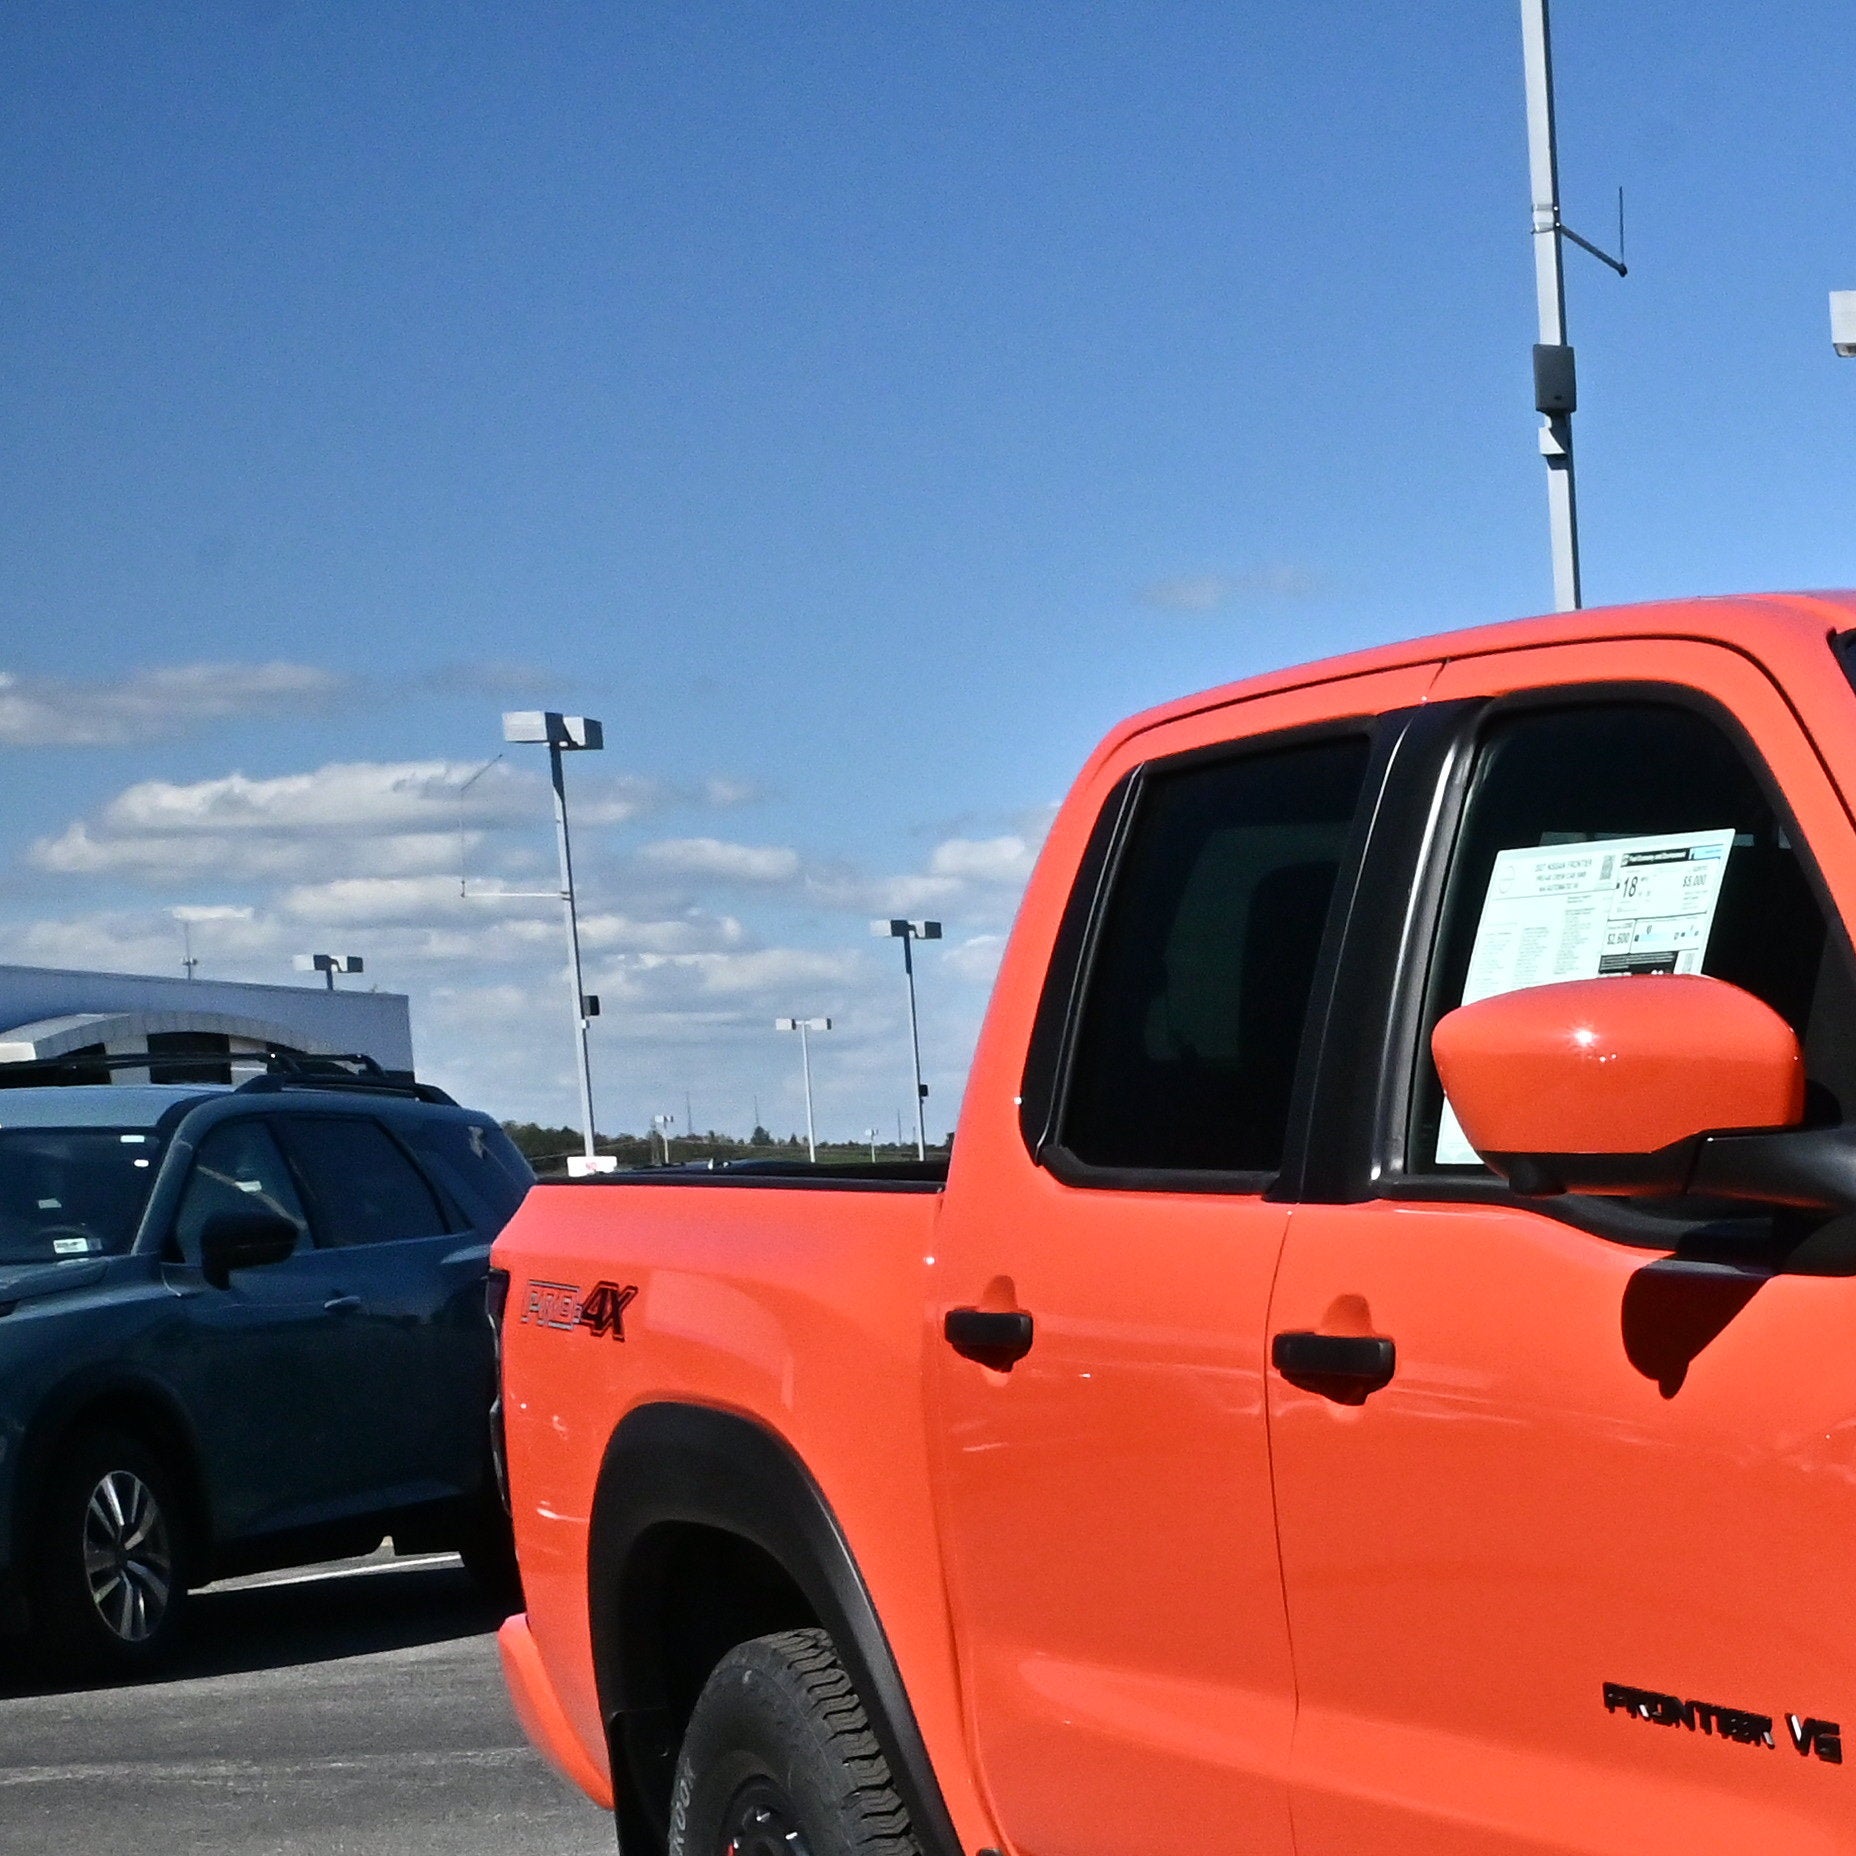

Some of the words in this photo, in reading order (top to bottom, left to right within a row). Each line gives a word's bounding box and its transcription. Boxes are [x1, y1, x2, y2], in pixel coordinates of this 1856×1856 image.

[1623, 876, 1639, 898] 18
[1602, 1682, 1776, 1750] FRONTIER
[1785, 1712, 1842, 1764] V6
